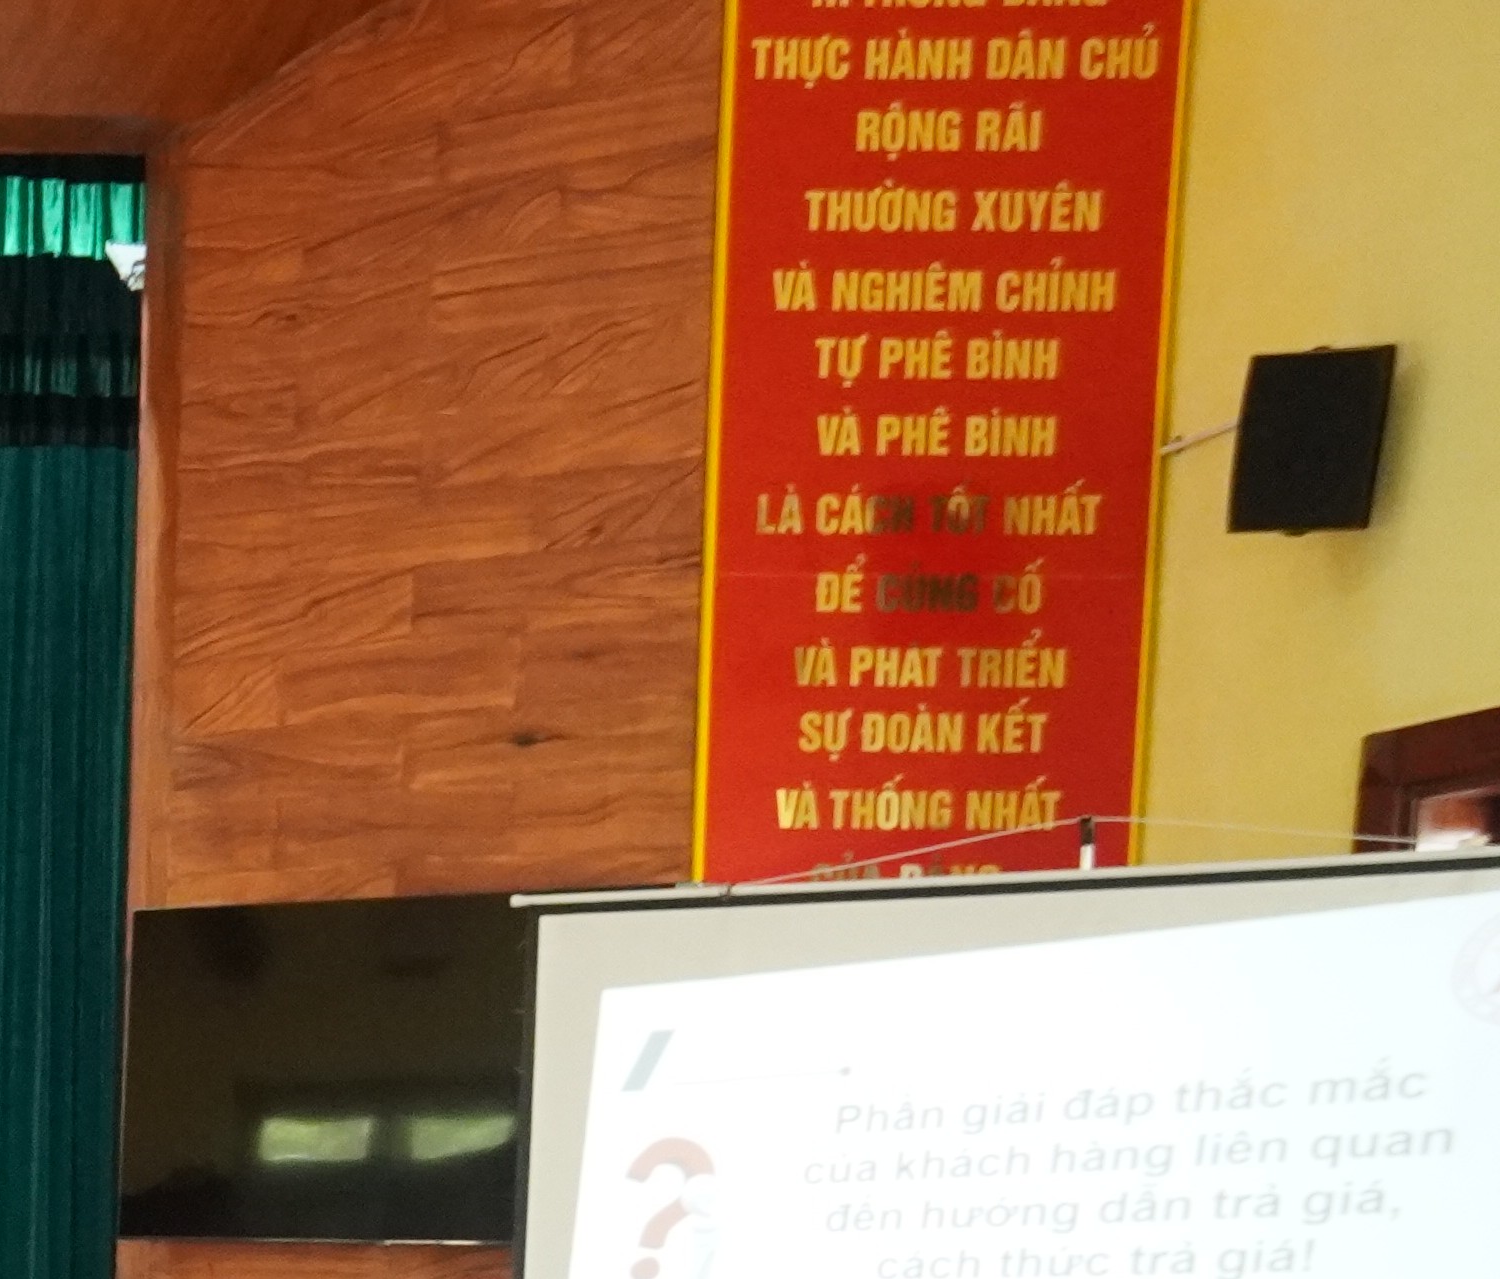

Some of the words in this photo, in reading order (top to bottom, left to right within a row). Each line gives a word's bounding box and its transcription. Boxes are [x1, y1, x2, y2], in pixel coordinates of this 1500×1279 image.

[752, 34, 852, 89] THỰC
[864, 28, 973, 81] HÀNH
[986, 29, 1066, 80] DÂN
[1079, 21, 1160, 81] CHỦ
[855, 101, 962, 161] RỘNG
[975, 101, 1043, 152] RÃI
[805, 178, 958, 233] THƯỜNG
[970, 180, 1104, 233] XUYÊN
[815, 334, 869, 388] TỰ
[878, 330, 952, 380] PHÊ
[965, 330, 1061, 380] BÌNH
[817, 406, 860, 458] VÀ
[877, 406, 951, 457] PHÊ
[964, 407, 1057, 457] BÌNH
[799, 709, 853, 761] SỰ
[860, 704, 964, 753] ĐOÀN
[976, 699, 1050, 753] KẾT
[777, 783, 817, 830] VÀ
[829, 775, 952, 831] THỐNG
[965, 777, 1063, 831] NHẤT
[834, 1100, 945, 1135] Phần
[962, 1092, 1045, 1134] giải
[1064, 1085, 1155, 1128] đáp
[1175, 1066, 1287, 1114] thắc
[1309, 1056, 1430, 1105] mắc
[802, 1150, 879, 1186] của
[895, 1146, 1032, 1182] khách
[1051, 1135, 1173, 1178] hàng
[1195, 1126, 1288, 1166] liên
[1310, 1124, 1456, 1164] quan
[1099, 1189, 1197, 1225] dẫn
[1212, 1181, 1283, 1220] trả
[1302, 1182, 1403, 1222] giá,
[999, 1245, 1110, 1278] thức
[1130, 1238, 1196, 1276] trả
